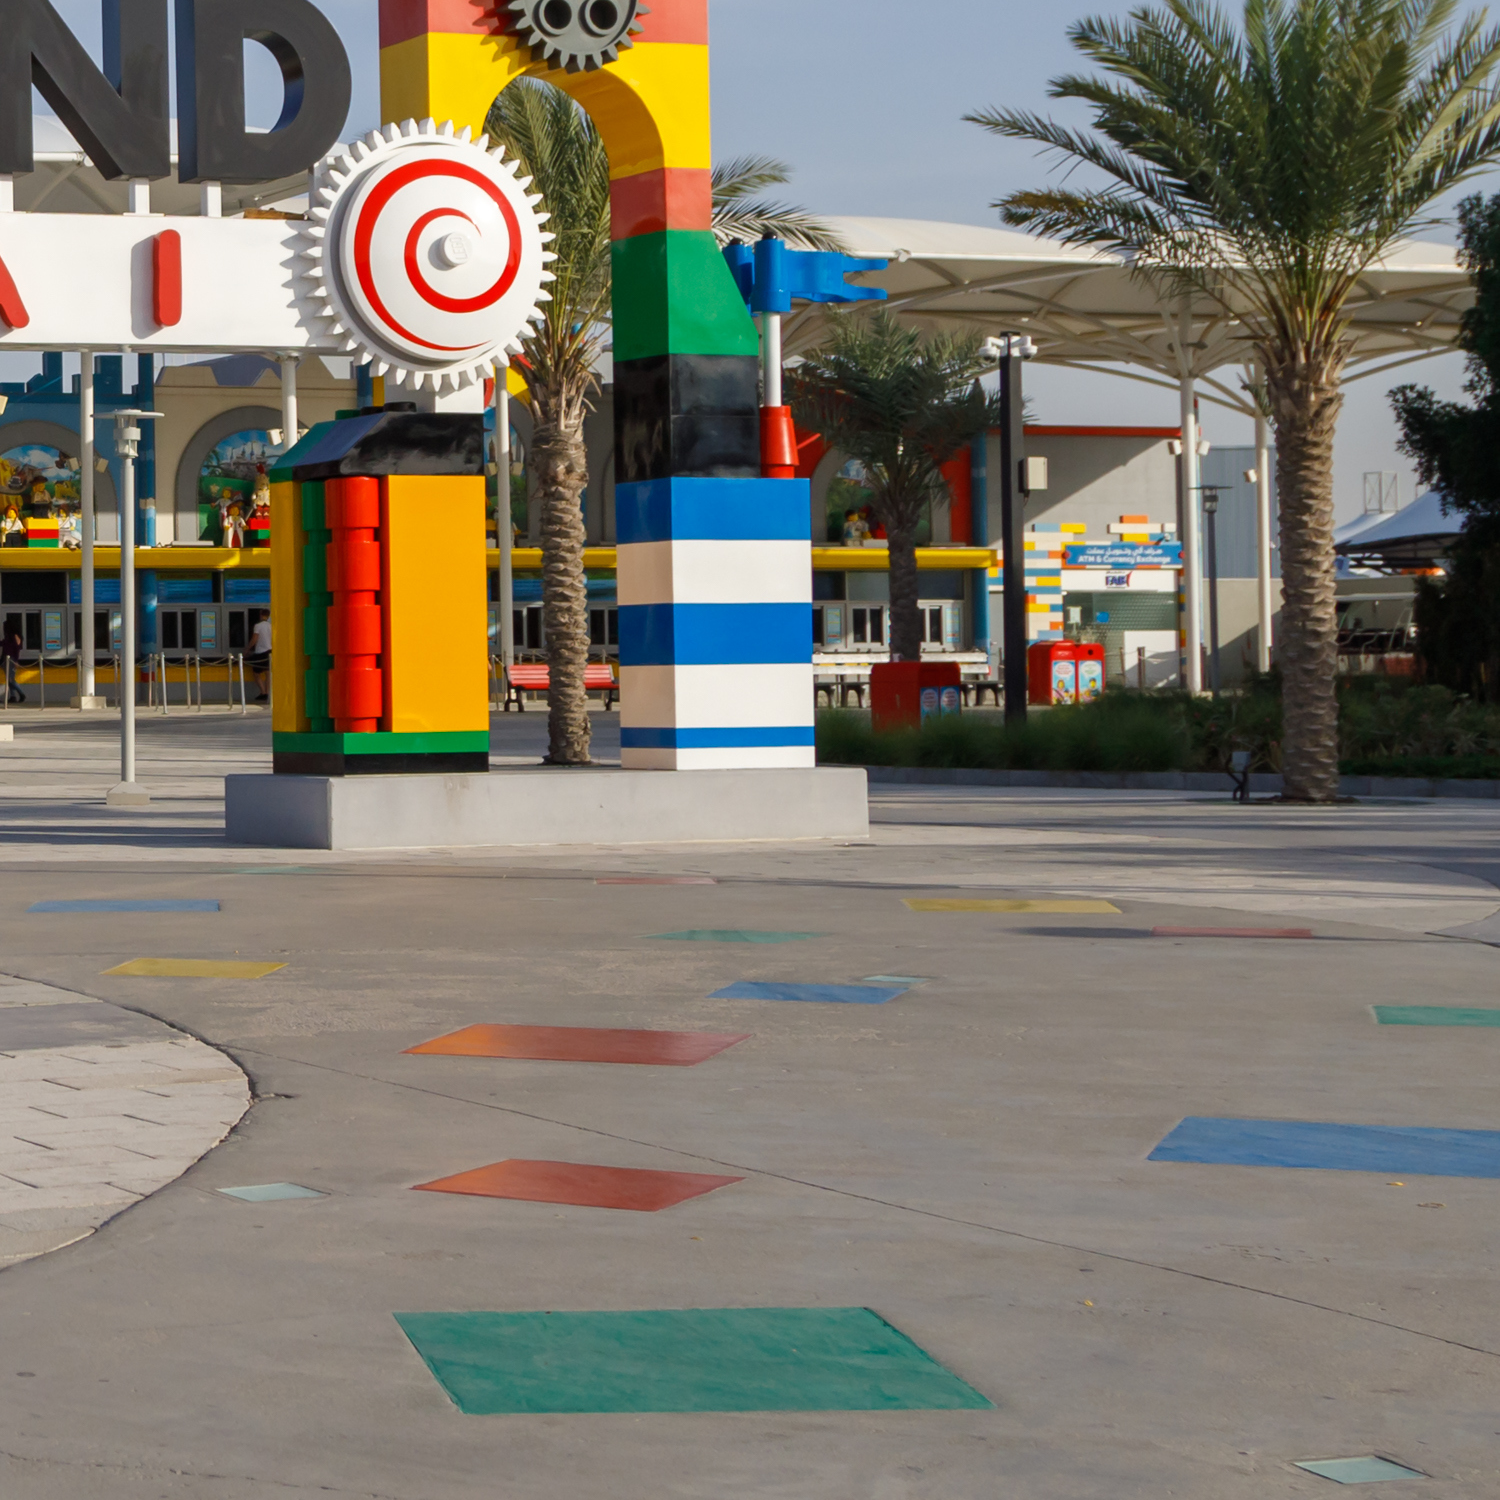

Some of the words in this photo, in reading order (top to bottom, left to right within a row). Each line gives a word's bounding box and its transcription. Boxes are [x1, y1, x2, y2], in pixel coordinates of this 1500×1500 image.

[1078, 555, 1096, 563] ATM
[1103, 555, 1135, 564] Currency
[1136, 555, 1171, 564] Exchange
